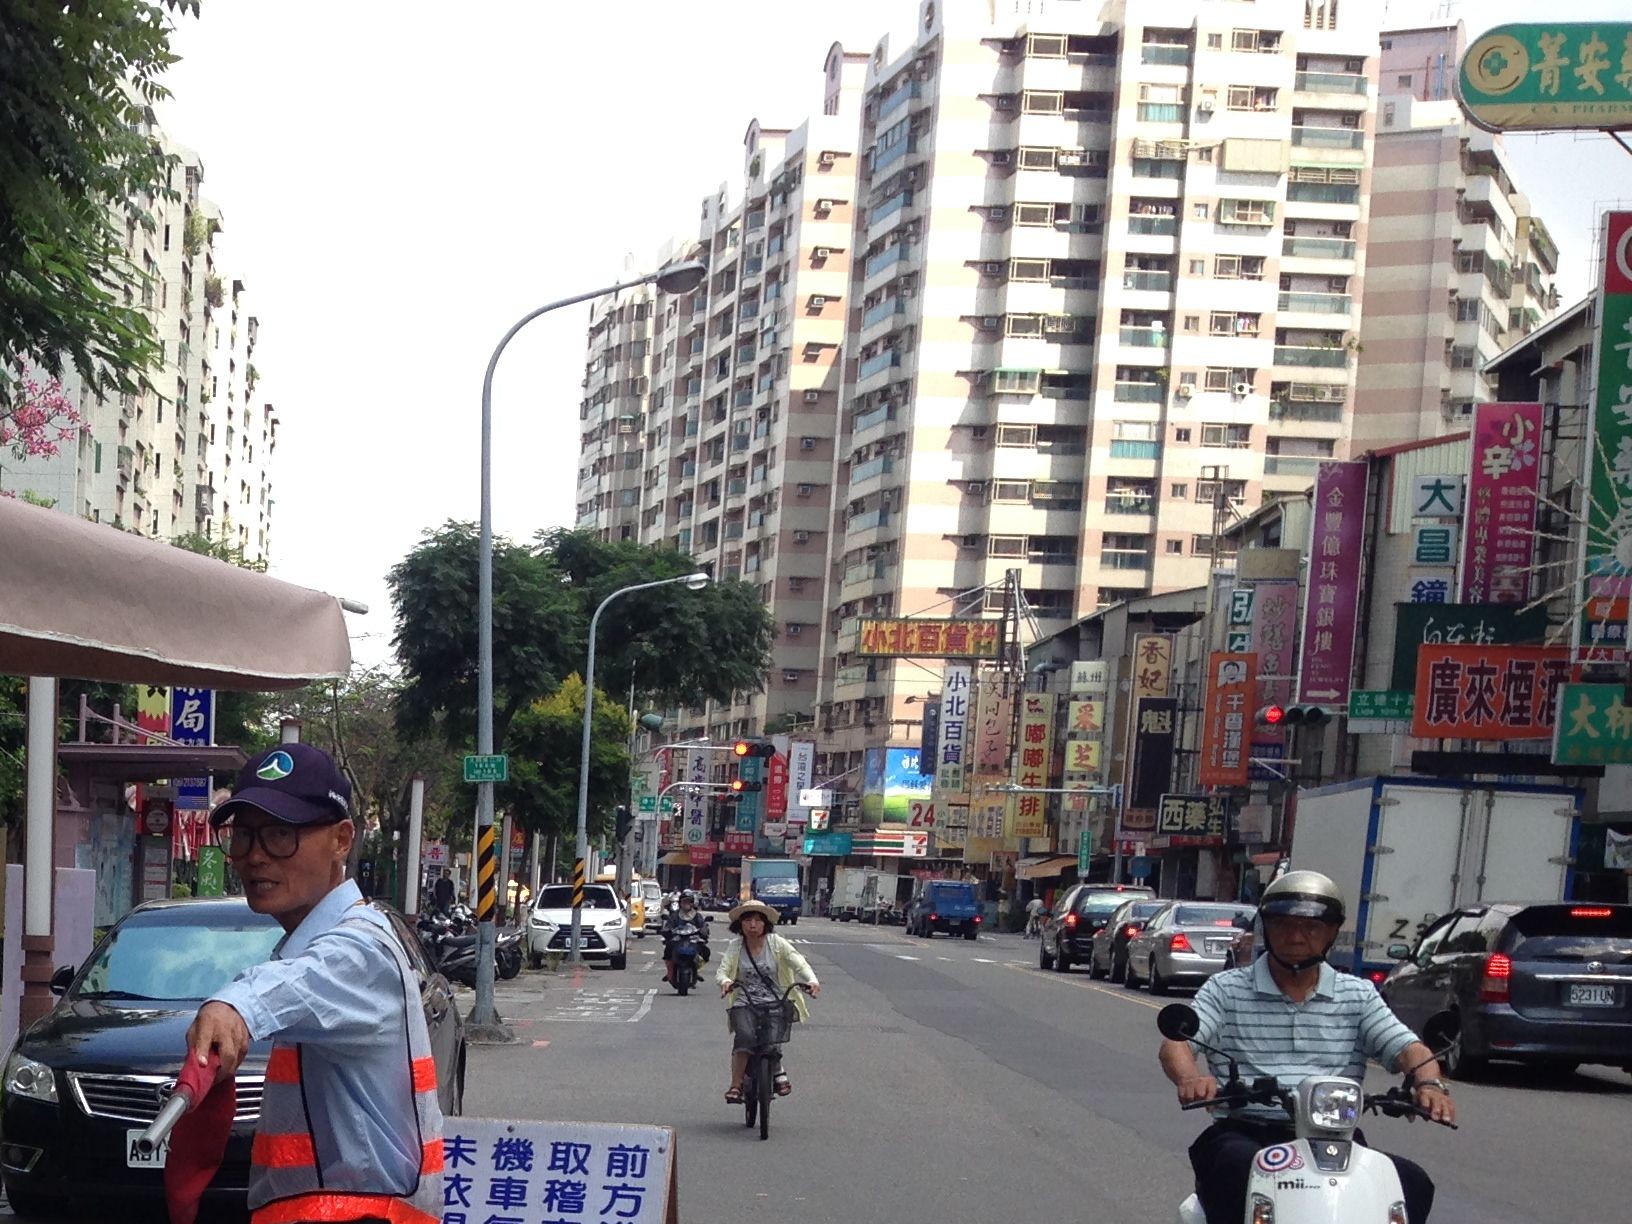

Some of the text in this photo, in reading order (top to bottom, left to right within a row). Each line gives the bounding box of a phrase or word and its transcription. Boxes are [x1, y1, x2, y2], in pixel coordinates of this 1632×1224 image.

[862, 623, 970, 653] 小北百貨
[1137, 641, 1167, 697] 香妃
[942, 671, 967, 766] 小北百貨
[1019, 723, 1046, 817] 嘟嘟牛排
[910, 803, 936, 827] 24
